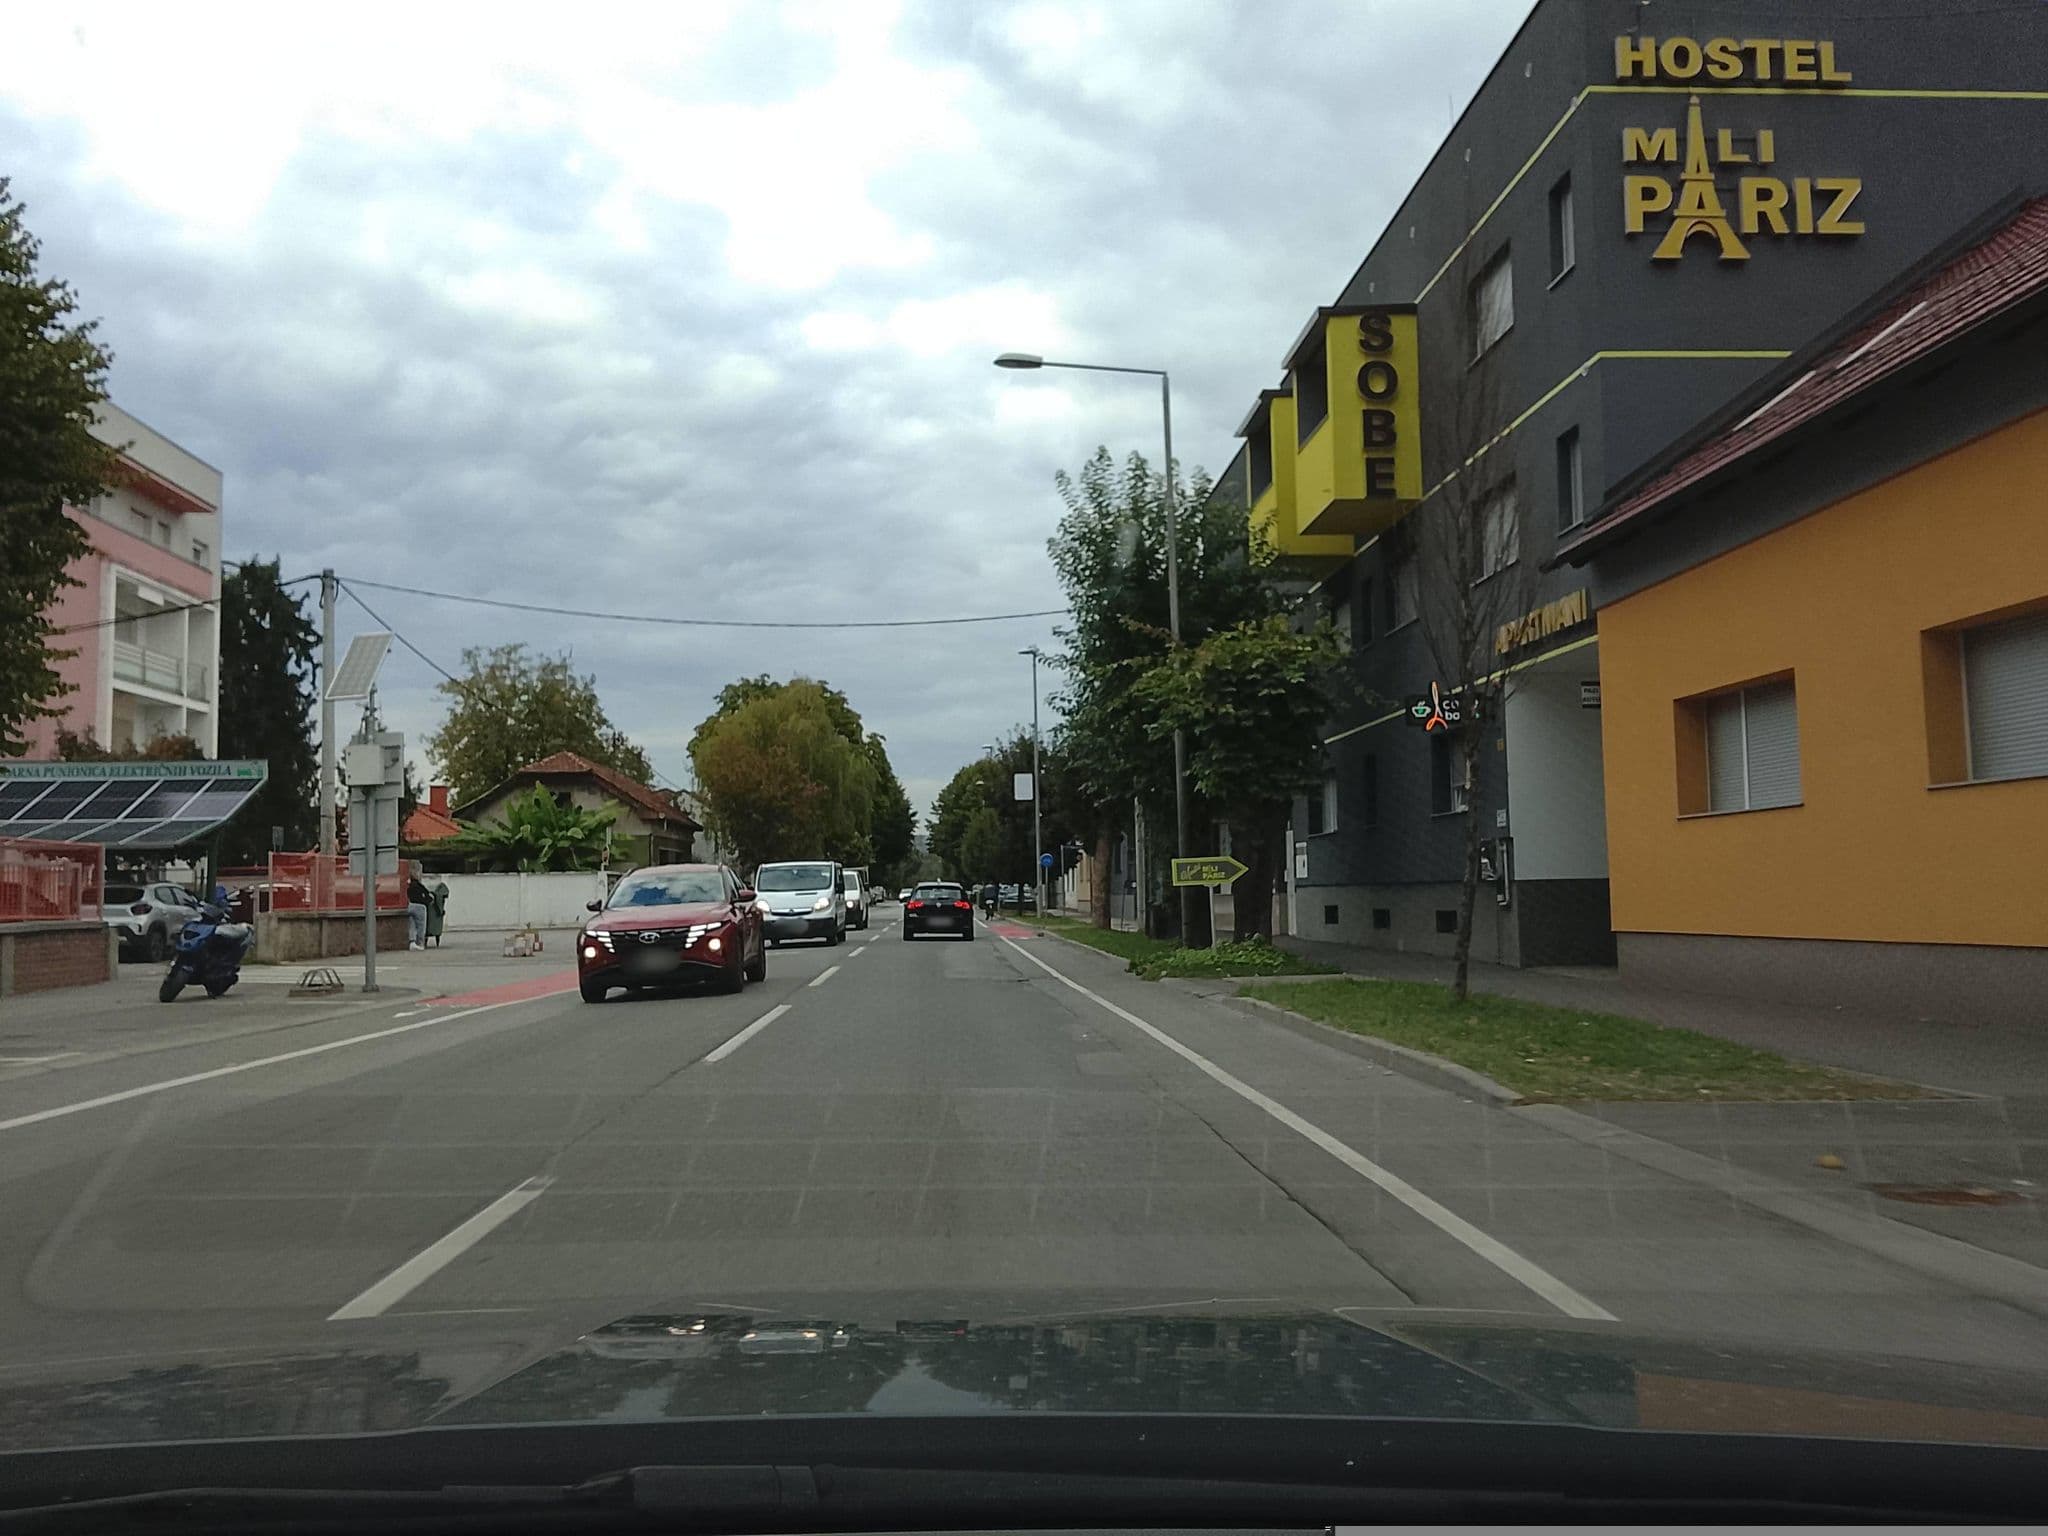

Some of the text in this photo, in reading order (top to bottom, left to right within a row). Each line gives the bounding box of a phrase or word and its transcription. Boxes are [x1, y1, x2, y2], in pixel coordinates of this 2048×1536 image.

[1614, 36, 1853, 82] HOSTEL
[1624, 175, 1866, 260] PARIZ
[1357, 313, 1399, 499] SOBE
[189, 765, 231, 776] VOZILA
